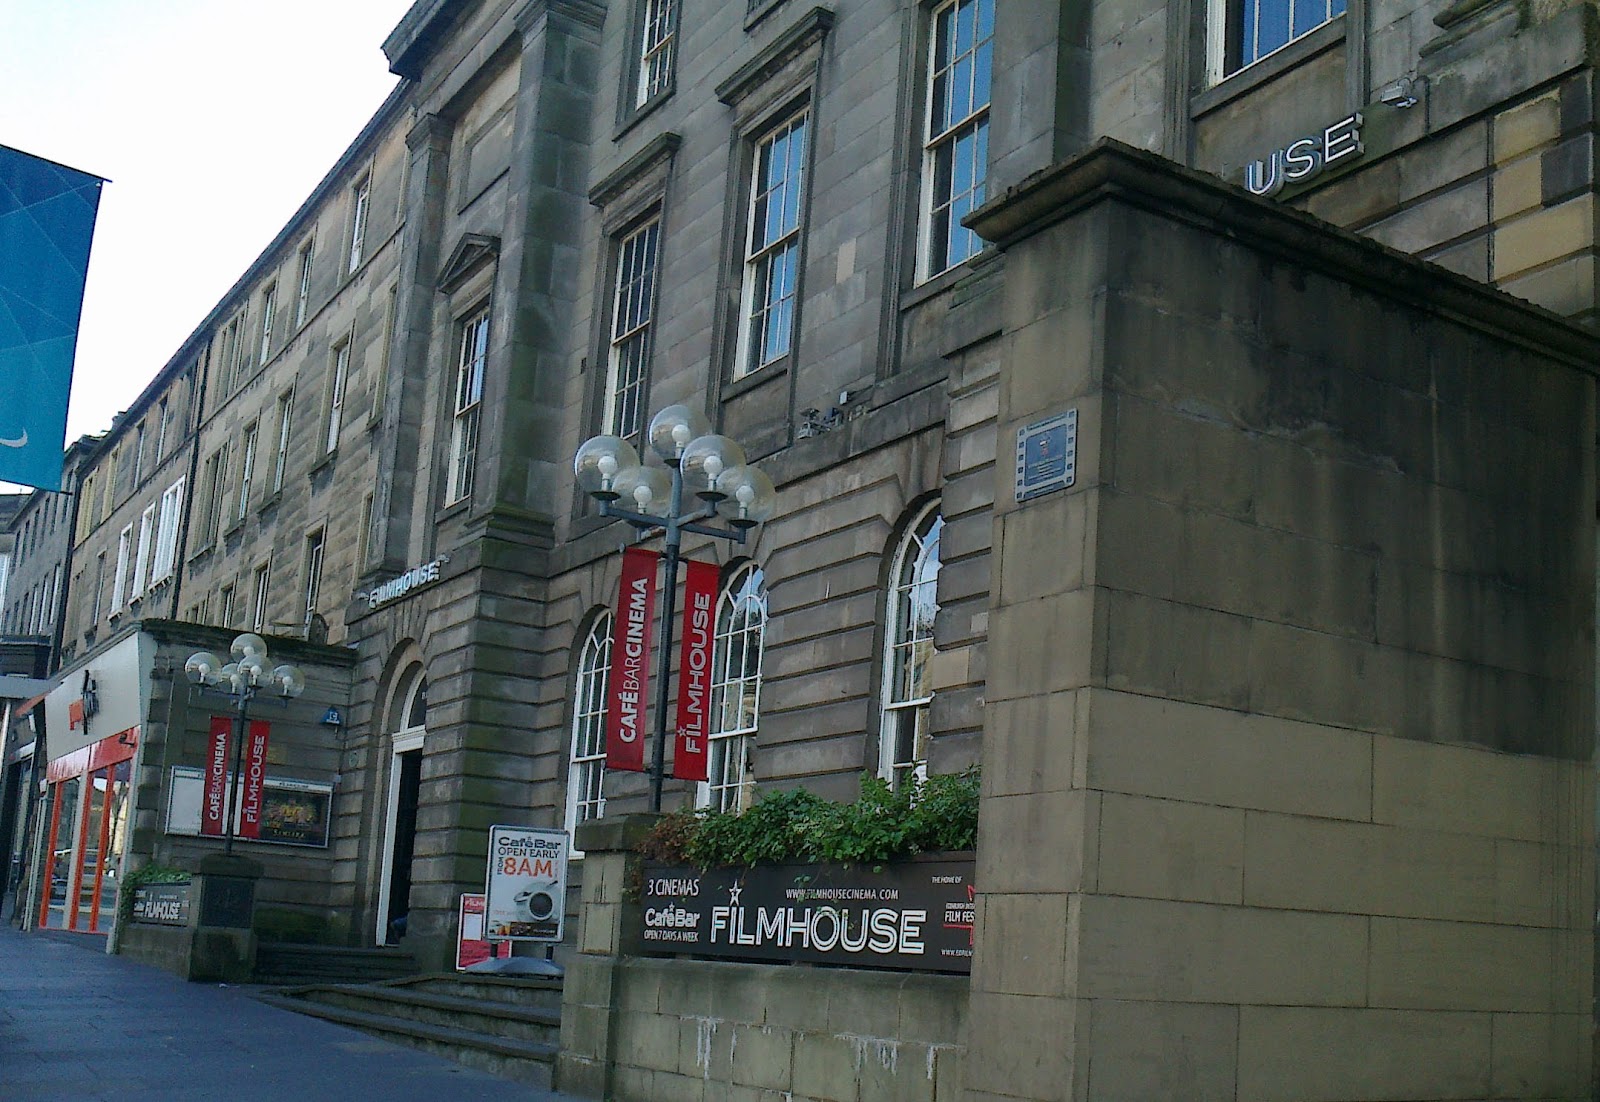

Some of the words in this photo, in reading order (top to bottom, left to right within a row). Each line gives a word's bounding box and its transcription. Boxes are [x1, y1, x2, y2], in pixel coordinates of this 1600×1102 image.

[1245, 112, 1365, 197] USE
[369, 561, 440, 609] FILMHOUSE
[685, 592, 711, 754] FILMHOUSE
[246, 735, 265, 823] FILMHOUSE
[498, 847, 527, 856] OPEN
[530, 849, 560, 859] EARLY
[503, 857, 553, 878] 8AM
[647, 879, 654, 896] 3
[655, 879, 699, 896] CINEMAS
[710, 905, 927, 955] FILMHOUSE
[944, 910, 961, 922] FILM
[644, 929, 658, 940] OPEN
